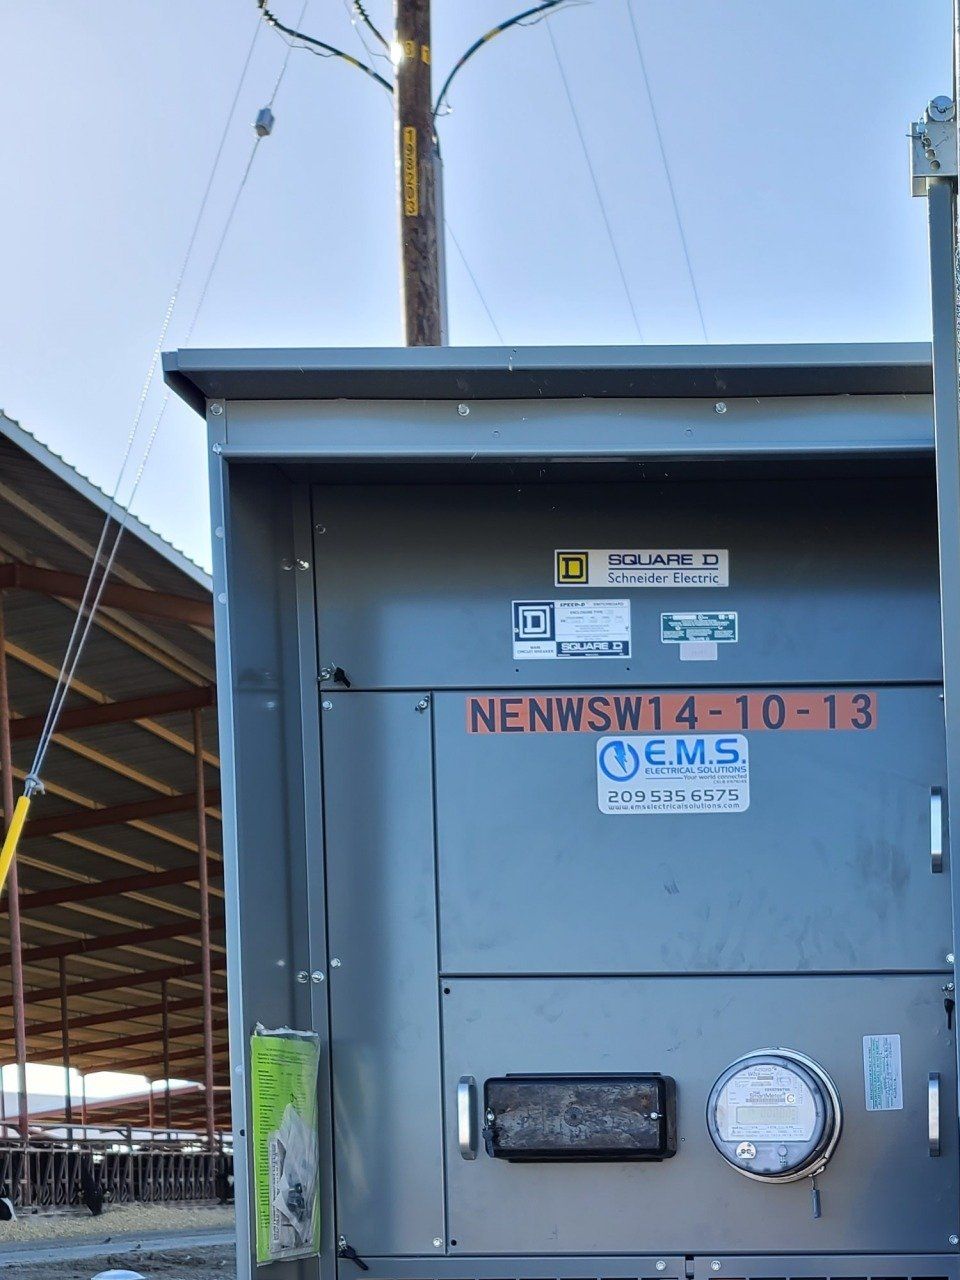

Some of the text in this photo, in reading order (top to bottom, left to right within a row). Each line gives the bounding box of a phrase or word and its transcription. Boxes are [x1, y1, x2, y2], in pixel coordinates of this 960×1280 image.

[608, 553, 719, 566] SQUARE D
[608, 571, 719, 584] Schneider Electric
[561, 641, 623, 651] SQUARE D
[470, 694, 873, 733] NENWSW14-10-13
[644, 738, 747, 766] E.M.S.
[645, 765, 747, 775] ELECTRICAL SOLUTIONS
[608, 789, 739, 803] 209 535 6575
[608, 802, 740, 811] www.emselectricalsolutions.com
